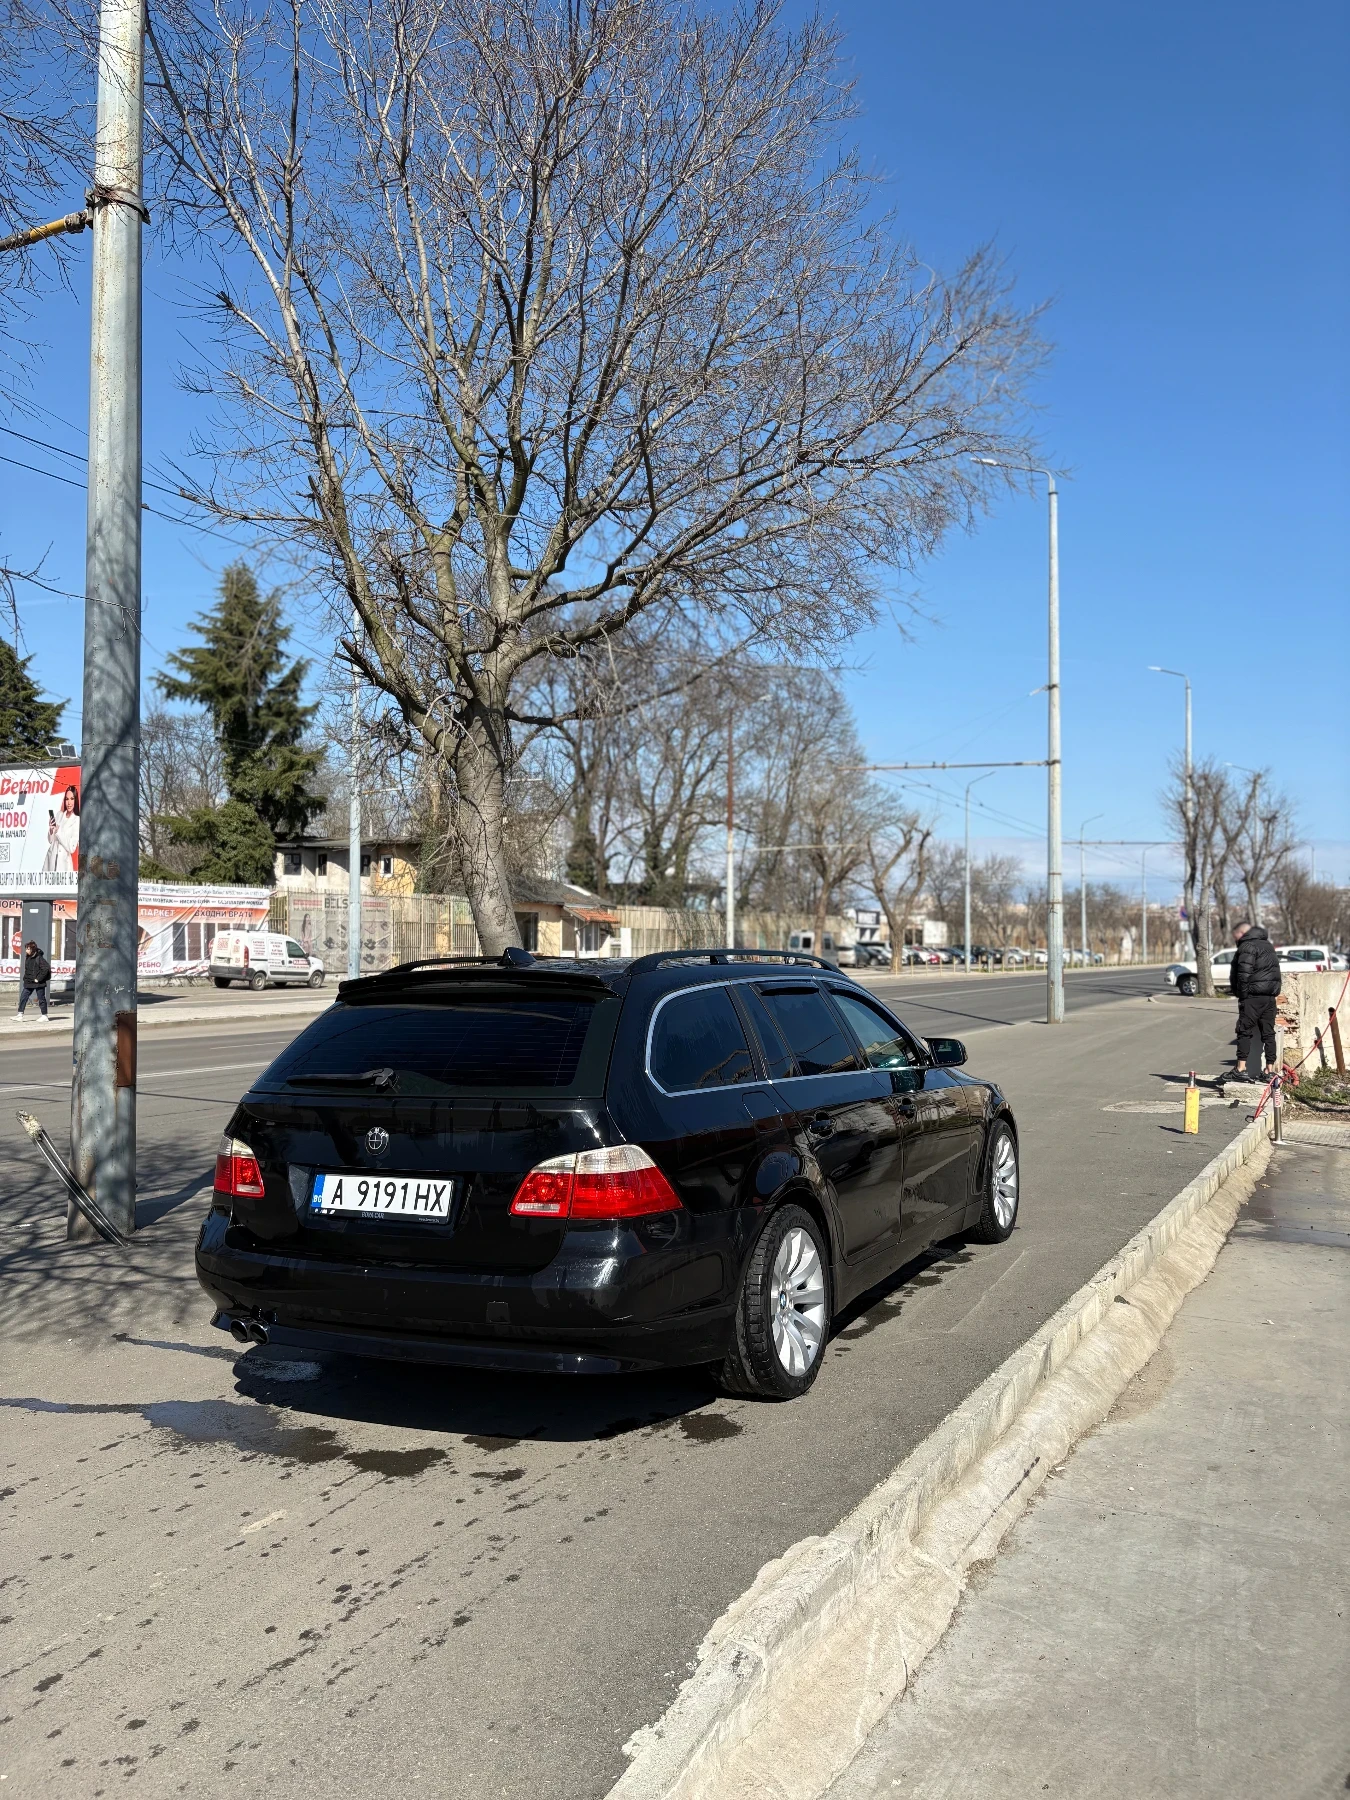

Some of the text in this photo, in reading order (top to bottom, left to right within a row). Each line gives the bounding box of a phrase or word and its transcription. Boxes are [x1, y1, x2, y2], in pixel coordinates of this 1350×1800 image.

[0, 778, 49, 795] Betano
[0, 812, 27, 828] НОВО
[6, 830, 26, 838] НАЧАЛО
[324, 898, 348, 909] BELS
[140, 908, 175, 917] ПАРКЕТ
[194, 909, 226, 918] ВХОДНИ
[313, 1194, 322, 1203] BG
[331, 1178, 447, 1213] A 9191 HX
